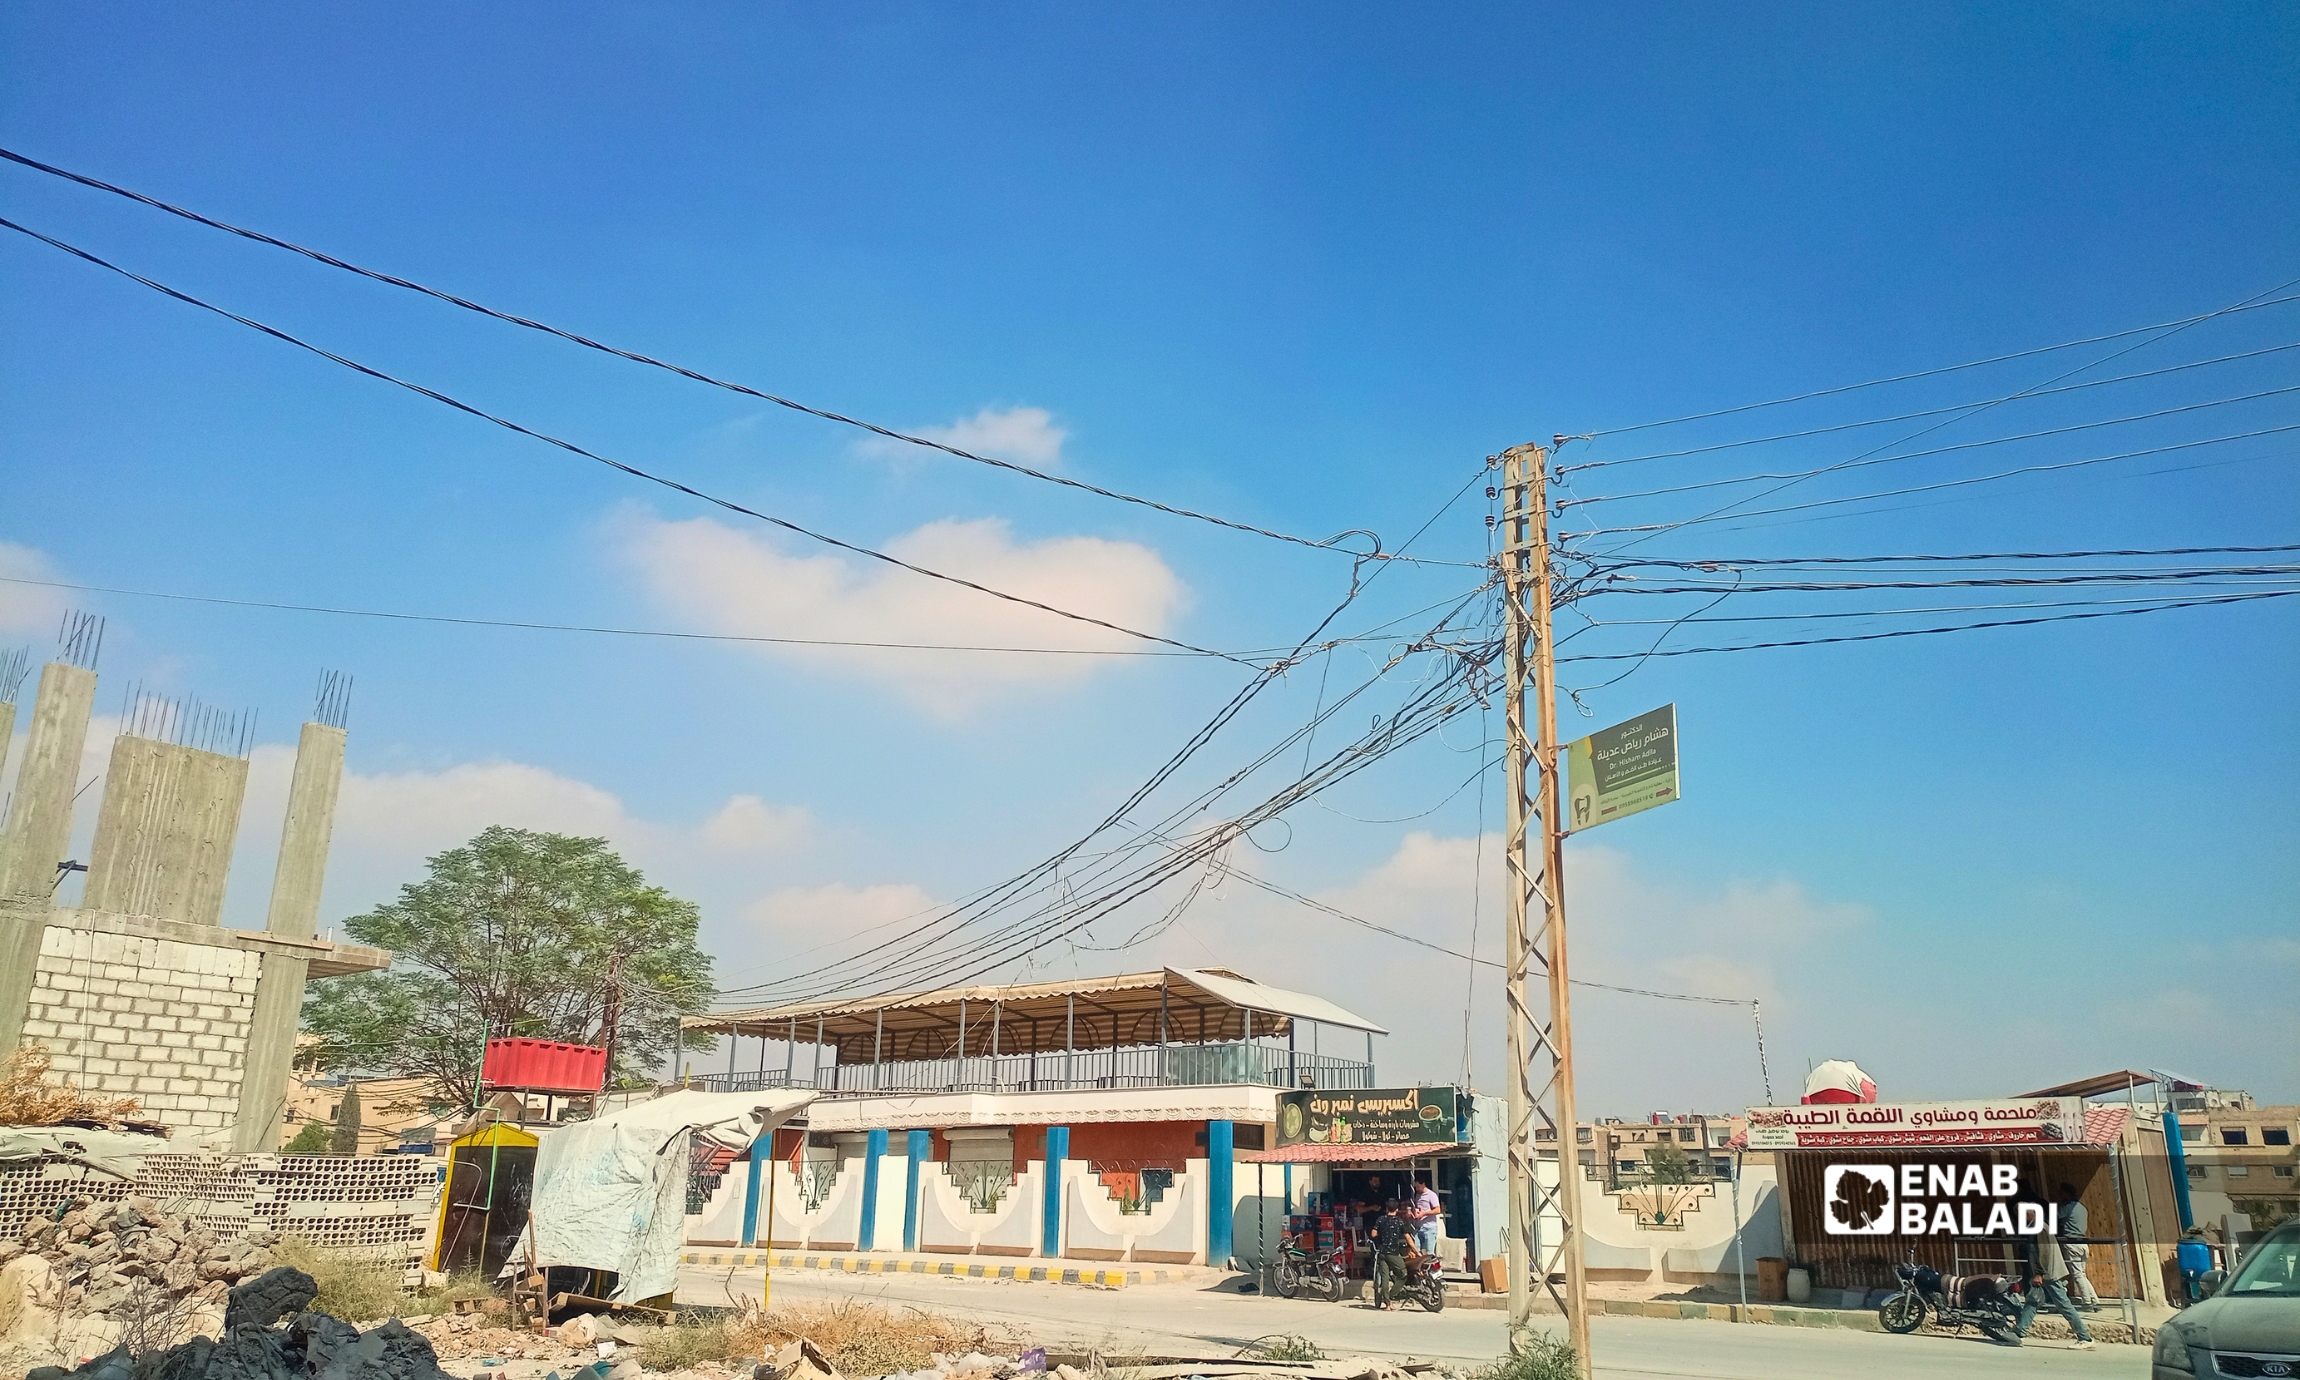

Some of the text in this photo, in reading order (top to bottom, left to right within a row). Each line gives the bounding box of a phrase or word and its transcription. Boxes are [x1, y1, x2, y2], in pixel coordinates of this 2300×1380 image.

[1620, 724, 1643, 740] الدكتور
[1597, 727, 1669, 761] هشام رياض عديلة
[1619, 755, 1641, 767] Hisham
[1309, 1089, 1419, 1116] اكسبريس نمبر ون
[1783, 1106, 2037, 1130] ملحمة ومشاوي اللقمة الطيبة
[1352, 1119, 1366, 1129] دخان
[1388, 1119, 1400, 1130] باردة
[1399, 1119, 1420, 1130] مشروبات
[1801, 1135, 1816, 1145] مشوية
[1816, 1135, 1825, 1144] كبة
[1829, 1134, 1842, 1145] مشوي
[1858, 1134, 1872, 1144] مشوي
[1873, 1135, 1885, 1144] كباب
[1888, 1133, 1902, 1144] مشوي
[1919, 1133, 1933, 1142] الفحم
[1935, 1133, 1946, 1142] على
[1946, 1133, 1960, 1142] فروج
[1988, 1131, 2005, 1142] مشاوي
[2008, 1131, 2025, 1141] خاروف
[2026, 1131, 2037, 1140] لحم
